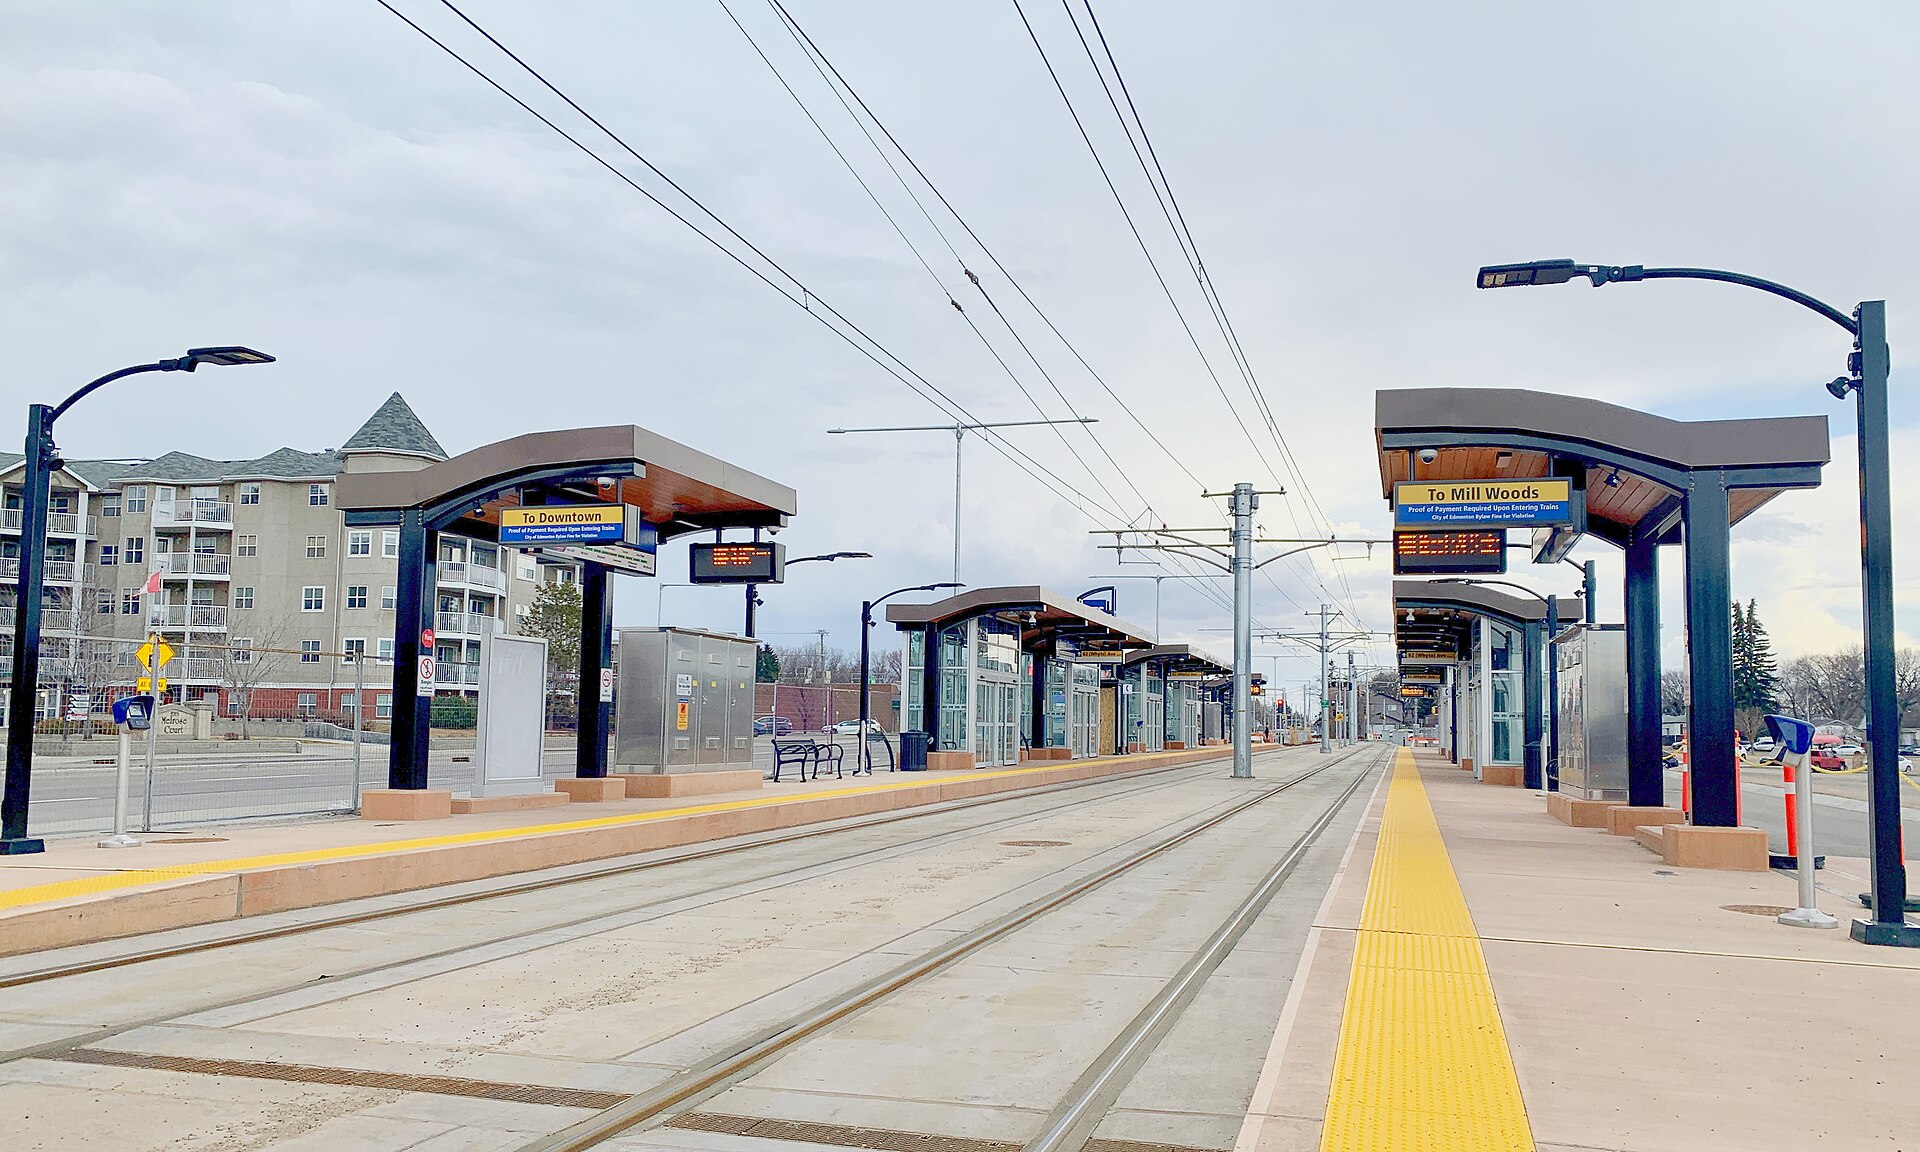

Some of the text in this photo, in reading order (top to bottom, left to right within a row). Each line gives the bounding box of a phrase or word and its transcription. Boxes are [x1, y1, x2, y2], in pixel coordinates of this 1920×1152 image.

[1428, 486, 1539, 501] To Mill Woods
[523, 512, 602, 523] To Downtown
[161, 715, 188, 725] Melrose
[164, 725, 184, 734] Court
